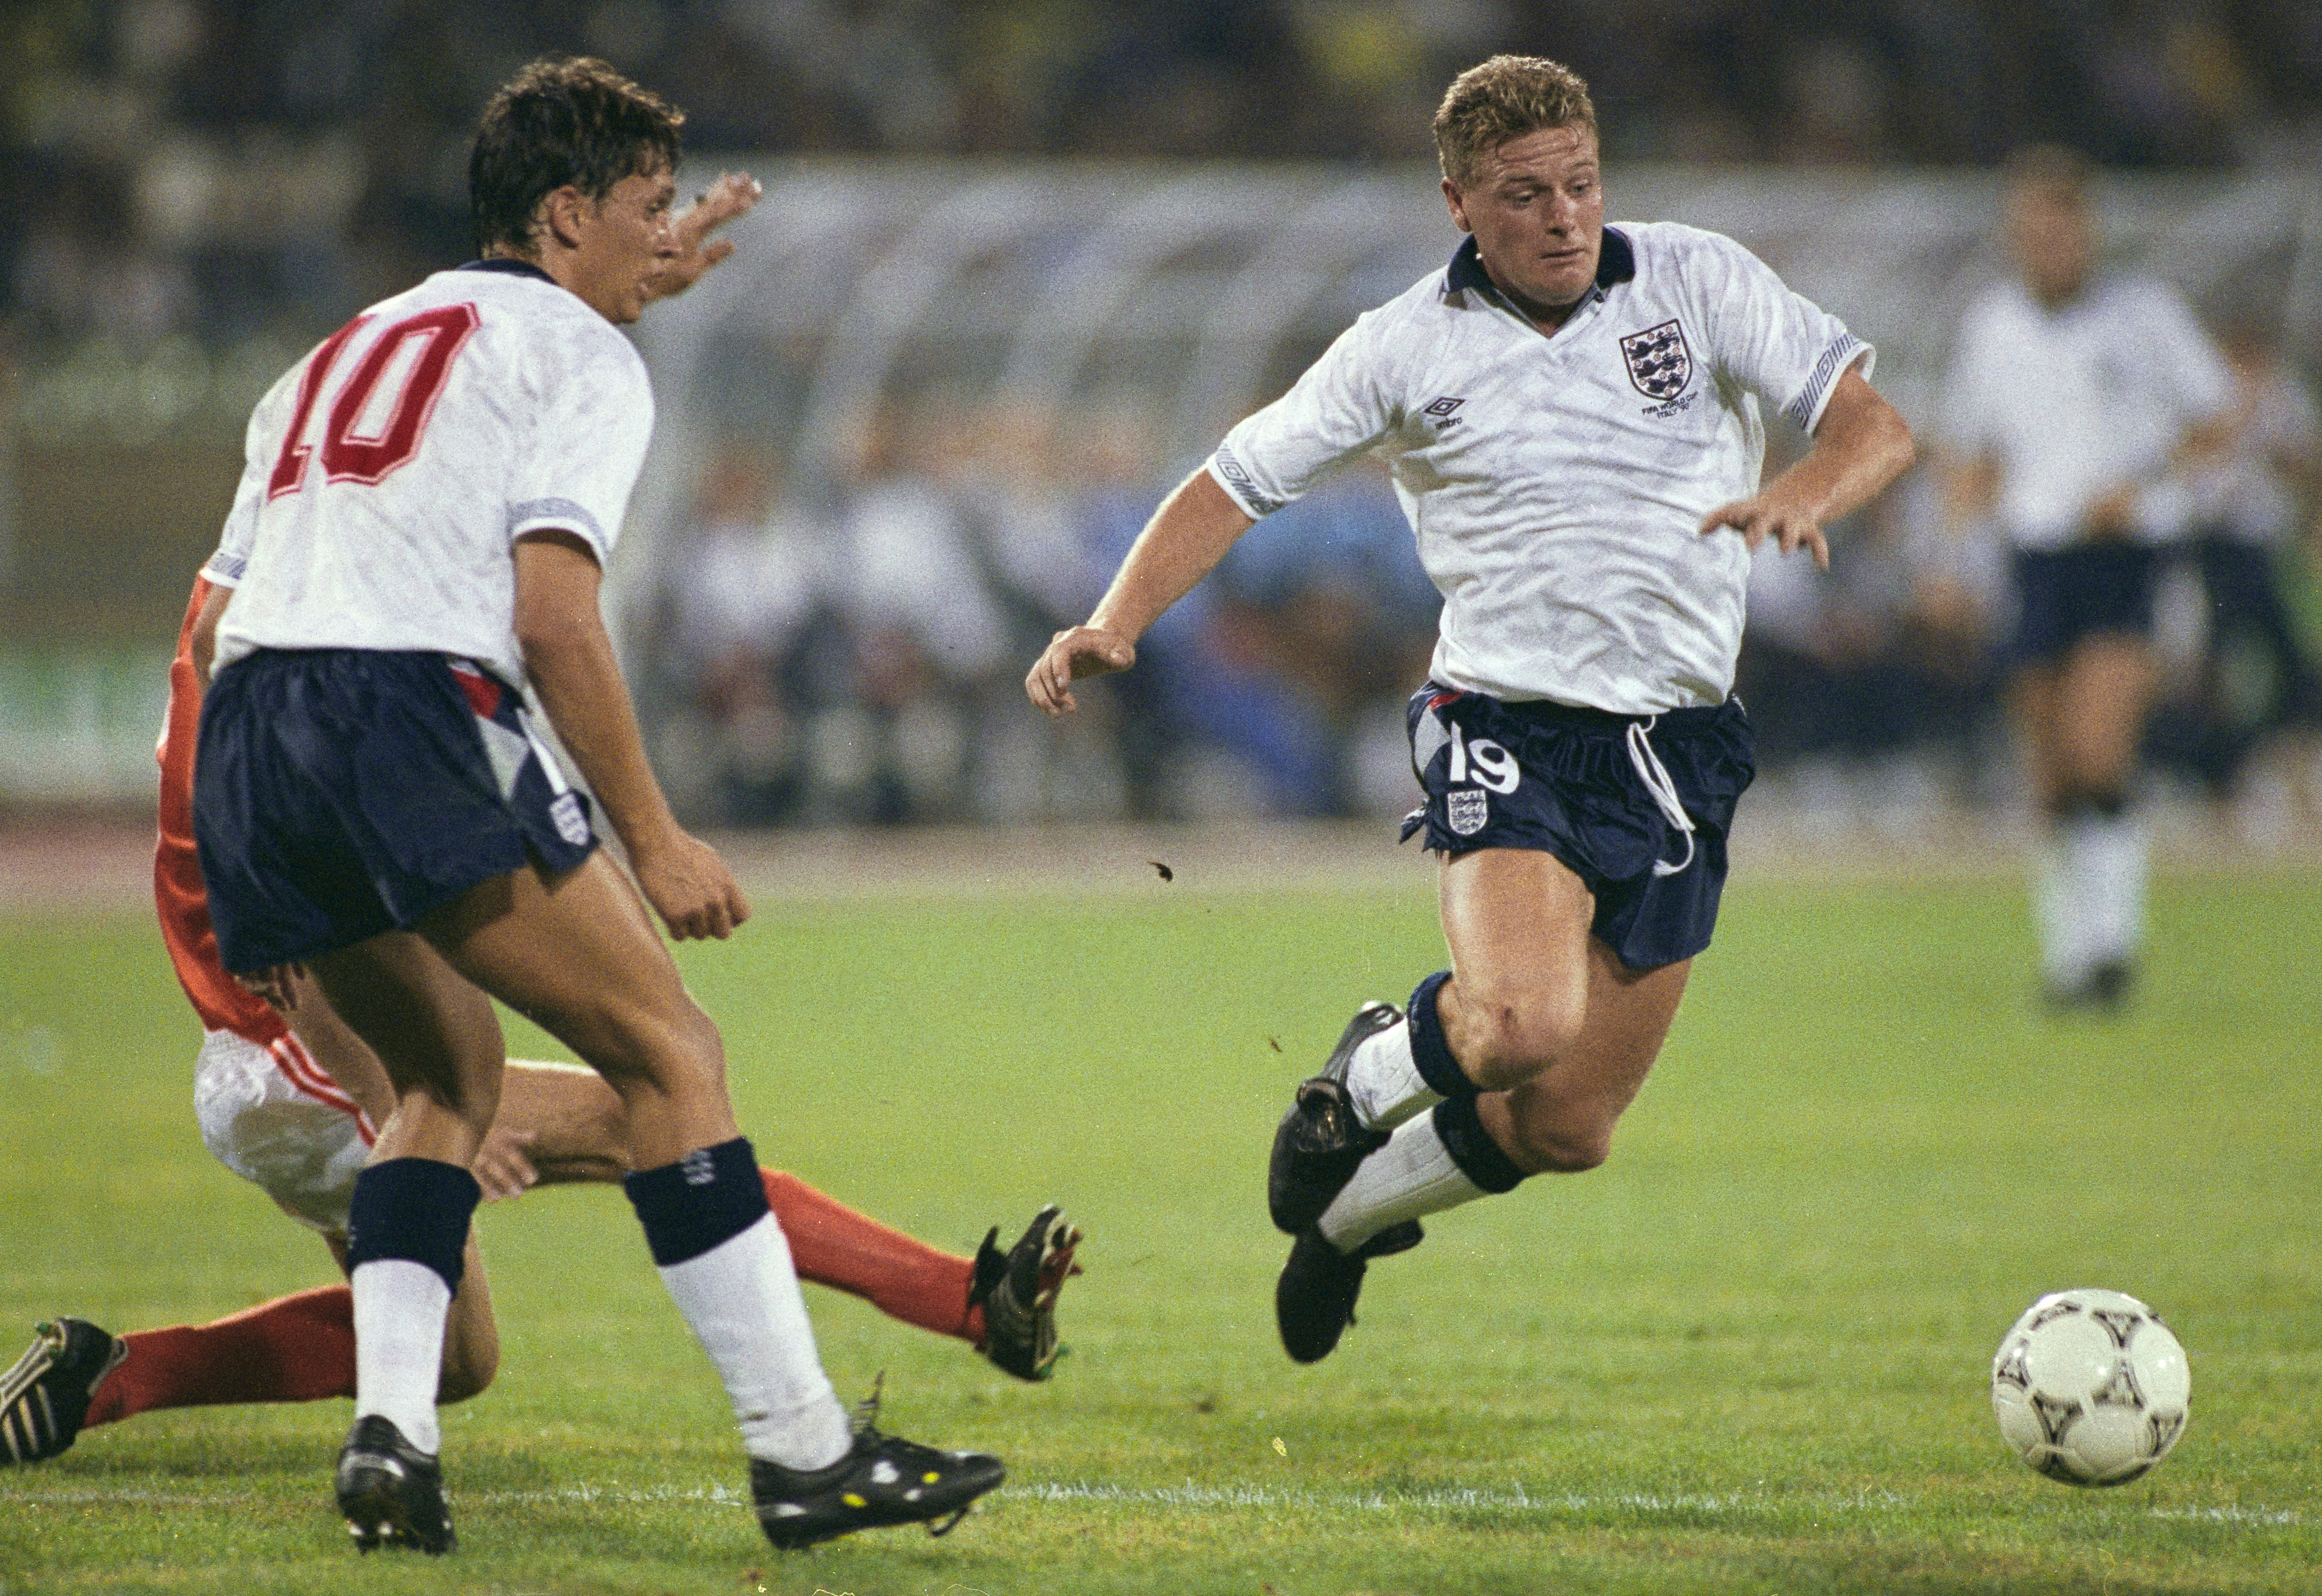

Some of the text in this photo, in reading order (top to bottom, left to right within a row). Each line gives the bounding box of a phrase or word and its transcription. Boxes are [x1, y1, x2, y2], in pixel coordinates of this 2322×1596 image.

[268, 302, 481, 503] 10
[1642, 405, 1659, 415] FIFA
[1660, 397, 1685, 410] WORLD
[1657, 407, 1677, 418] ITALY
[1450, 720, 1519, 794] 19
